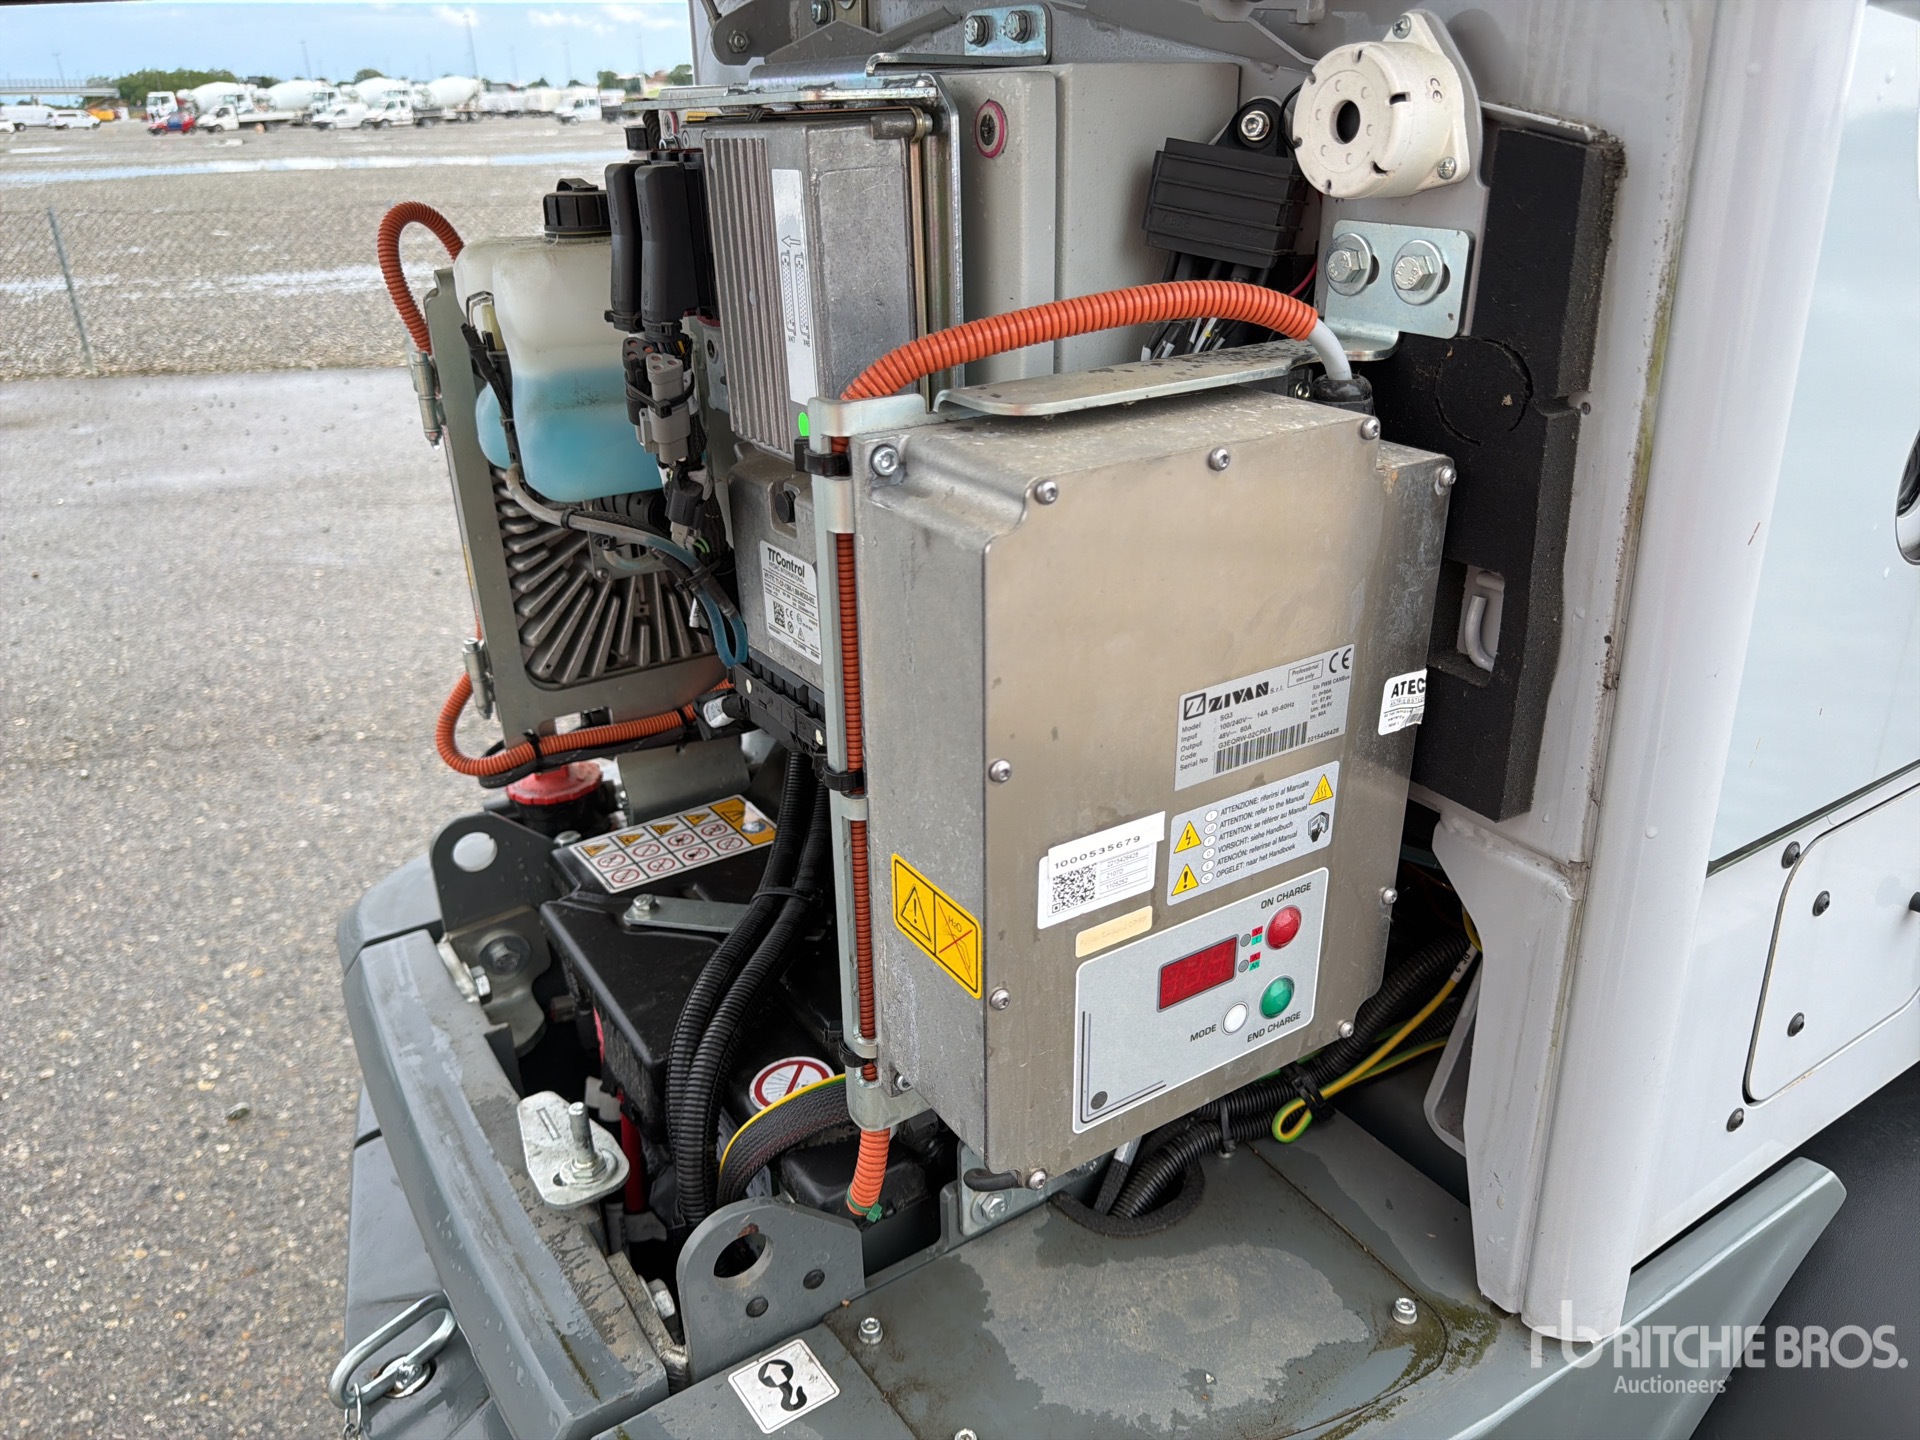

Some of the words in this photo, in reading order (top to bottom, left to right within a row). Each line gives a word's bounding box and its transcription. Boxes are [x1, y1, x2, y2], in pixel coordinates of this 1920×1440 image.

[1292, 664, 1318, 676] Professional
[1328, 648, 1351, 674] CE
[1304, 672, 1314, 680] only
[1208, 681, 1269, 712] ZIVAN
[1181, 732, 1197, 743] Input
[1257, 709, 1267, 718] 14A
[1271, 701, 1294, 714] 50-60Hz
[1182, 721, 1201, 733] Model
[1219, 711, 1232, 721] SG3
[1179, 751, 1196, 761] Code
[1180, 739, 1202, 753] Output
[1179, 759, 1198, 771] Serial
[1199, 756, 1208, 764] No
[1219, 812, 1253, 828] ATTENTION:
[1254, 805, 1267, 816] refer
[1275, 799, 1284, 808] the
[1285, 793, 1304, 805] Manual
[1220, 798, 1259, 816] ATTENZIONE:
[1260, 790, 1279, 802] riferirsi
[1286, 779, 1309, 793] Manuale
[1218, 824, 1253, 841] ATTENTION:
[1287, 804, 1307, 816] Manuel
[1217, 838, 1249, 853] VORSICHT:
[1250, 831, 1264, 841] siehe
[1265, 821, 1292, 836] Handbuch
[1248, 841, 1271, 854] referirse
[1277, 831, 1297, 843] Manual
[1055, 835, 1141, 869] 1000535679
[1216, 862, 1245, 878] OPGELET:
[1245, 857, 1257, 867] naar
[1259, 852, 1267, 861] het
[1268, 843, 1295, 858] Handboek
[1261, 895, 1275, 909] ON
[1276, 882, 1312, 903] CHARGE
[1190, 1024, 1217, 1042] MODE
[1247, 1026, 1266, 1043] END
[1267, 1011, 1301, 1033] CHARGE
